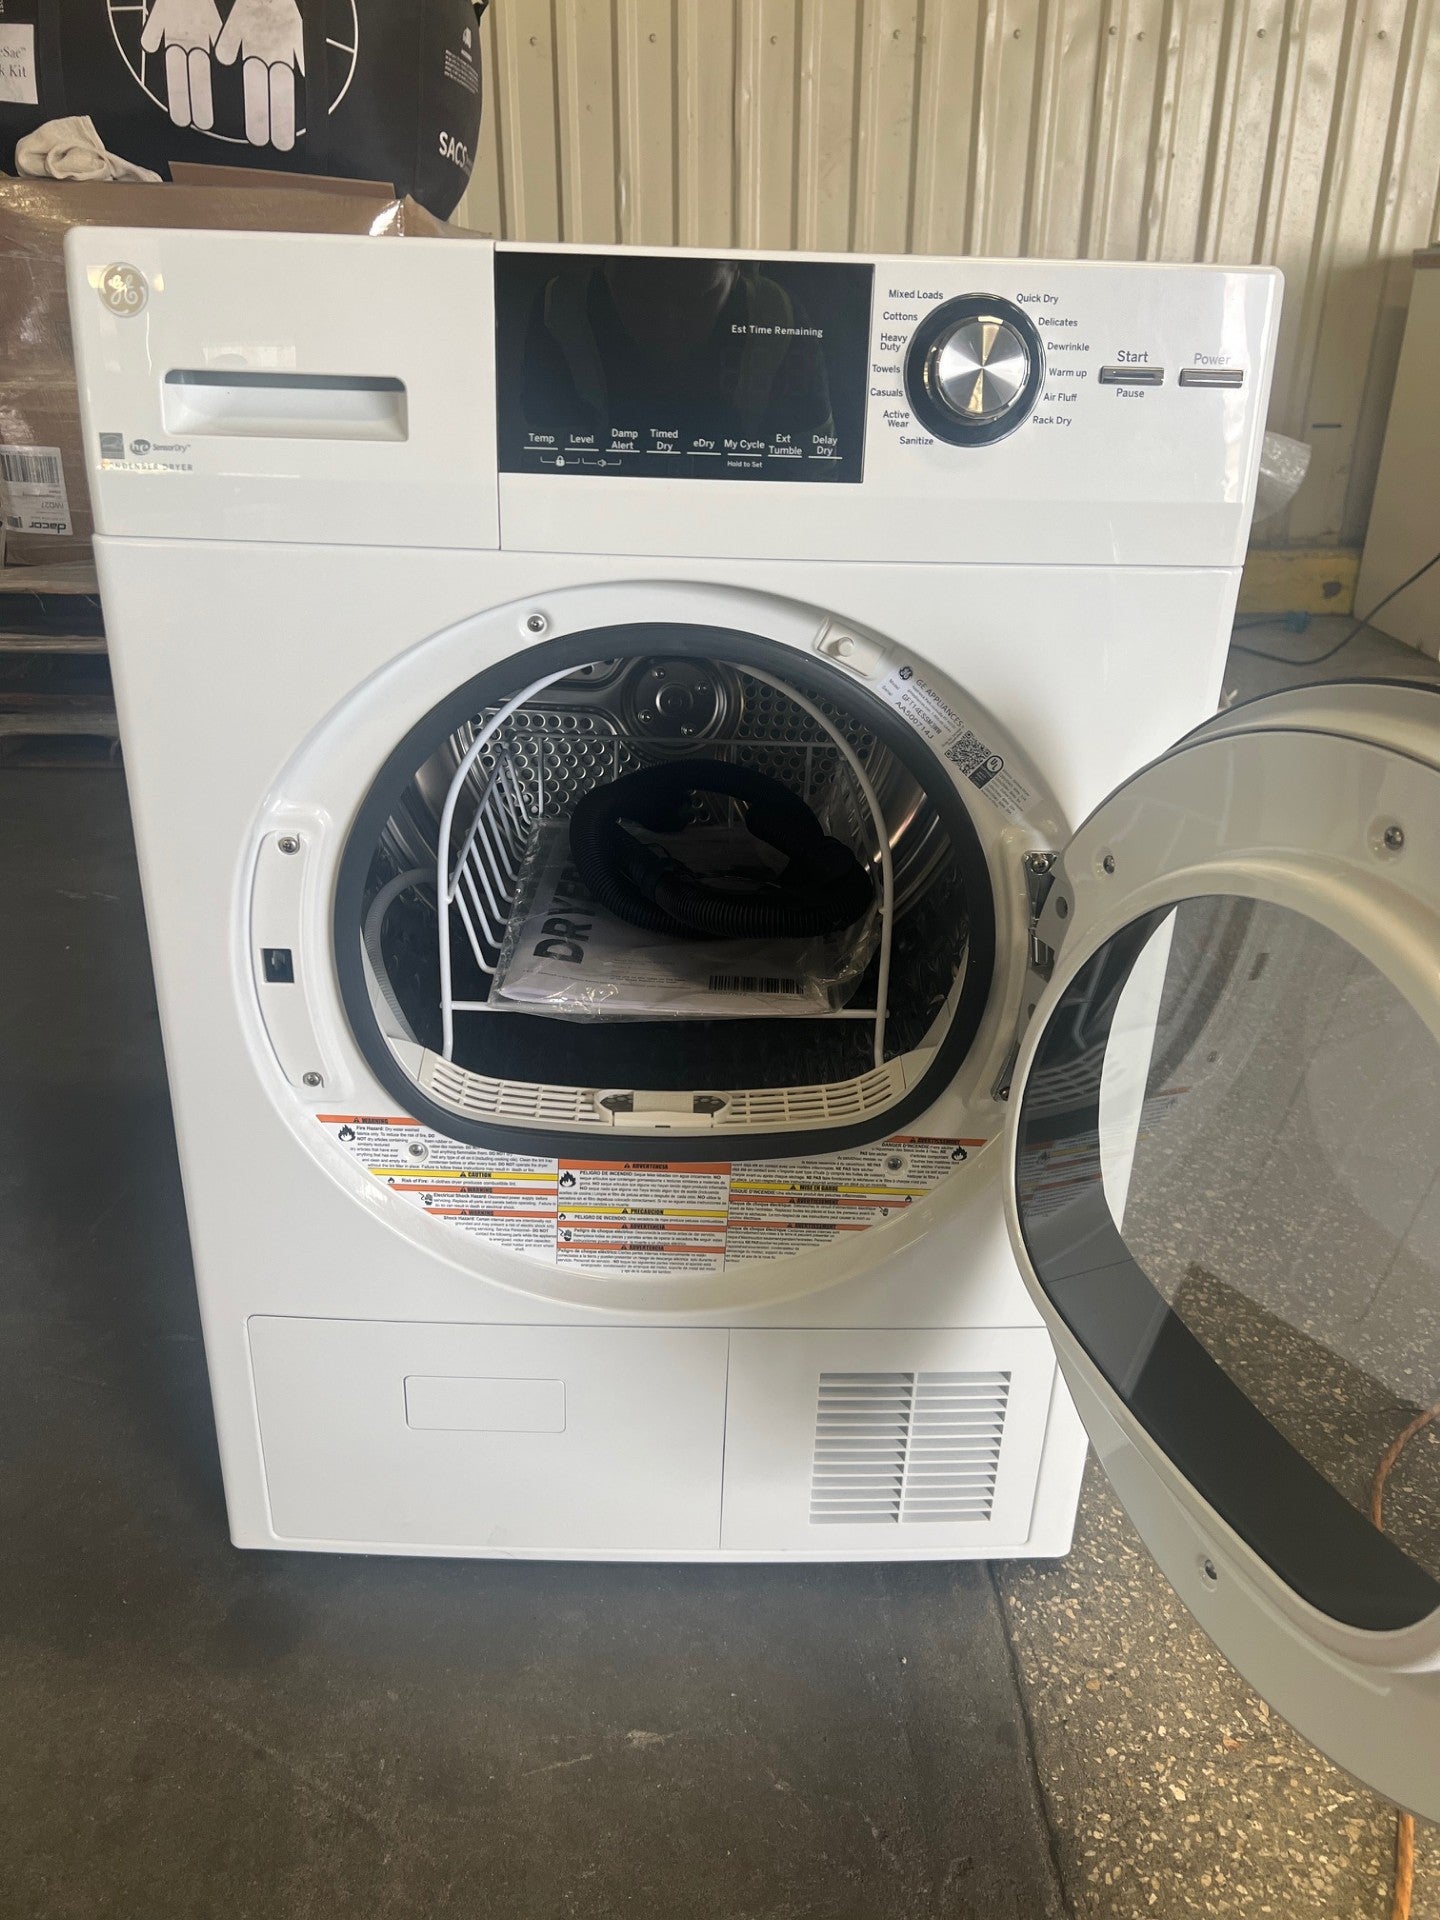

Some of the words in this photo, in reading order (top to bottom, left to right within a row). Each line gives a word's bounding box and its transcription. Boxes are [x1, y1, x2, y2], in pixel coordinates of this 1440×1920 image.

[888, 289, 915, 299] Mixed
[917, 290, 944, 300] Loads
[1016, 293, 1041, 304] Quick
[1043, 294, 1059, 305] Dry
[882, 311, 918, 321] Cottons
[1038, 317, 1079, 327] Delicates
[731, 324, 747, 334] Est
[749, 325, 772, 335] Time
[774, 325, 824, 338] Remaining
[880, 332, 908, 344] Heavy
[880, 342, 901, 353] Duty
[1047, 341, 1090, 351] Dewrinkle
[1117, 349, 1149, 363] Start
[1193, 352, 1232, 366] Power
[872, 364, 901, 373] Towels
[1049, 367, 1074, 377] Warm
[1076, 370, 1088, 379] up
[870, 387, 904, 397] Casuals
[1043, 392, 1056, 402] Air
[1057, 393, 1078, 402] Fluff
[1116, 387, 1145, 398] Pause
[882, 409, 910, 419] Active
[887, 419, 909, 428] Wear
[1032, 415, 1054, 425] Rack
[1056, 416, 1072, 427] Dry
[528, 432, 555, 445] Temp
[570, 434, 595, 444] Level
[611, 428, 639, 440] Damp
[650, 429, 679, 439] Timed
[776, 433, 792, 444] Ext
[611, 440, 634, 450] Alert
[693, 438, 715, 449] eDry
[724, 439, 739, 450] My
[740, 440, 766, 450] Cycle
[812, 434, 838, 446] Delay
[899, 435, 934, 446] Sanitize
[656, 441, 674, 452] Dry
[768, 445, 803, 455] Tumble
[816, 446, 834, 457] Dry
[101, 462, 158, 471] CNDENSER
[727, 460, 742, 468] Hold
[751, 461, 763, 469] Set
[29, 521, 67, 533] dacor
[926, 688, 965, 728] APPLIANCES
